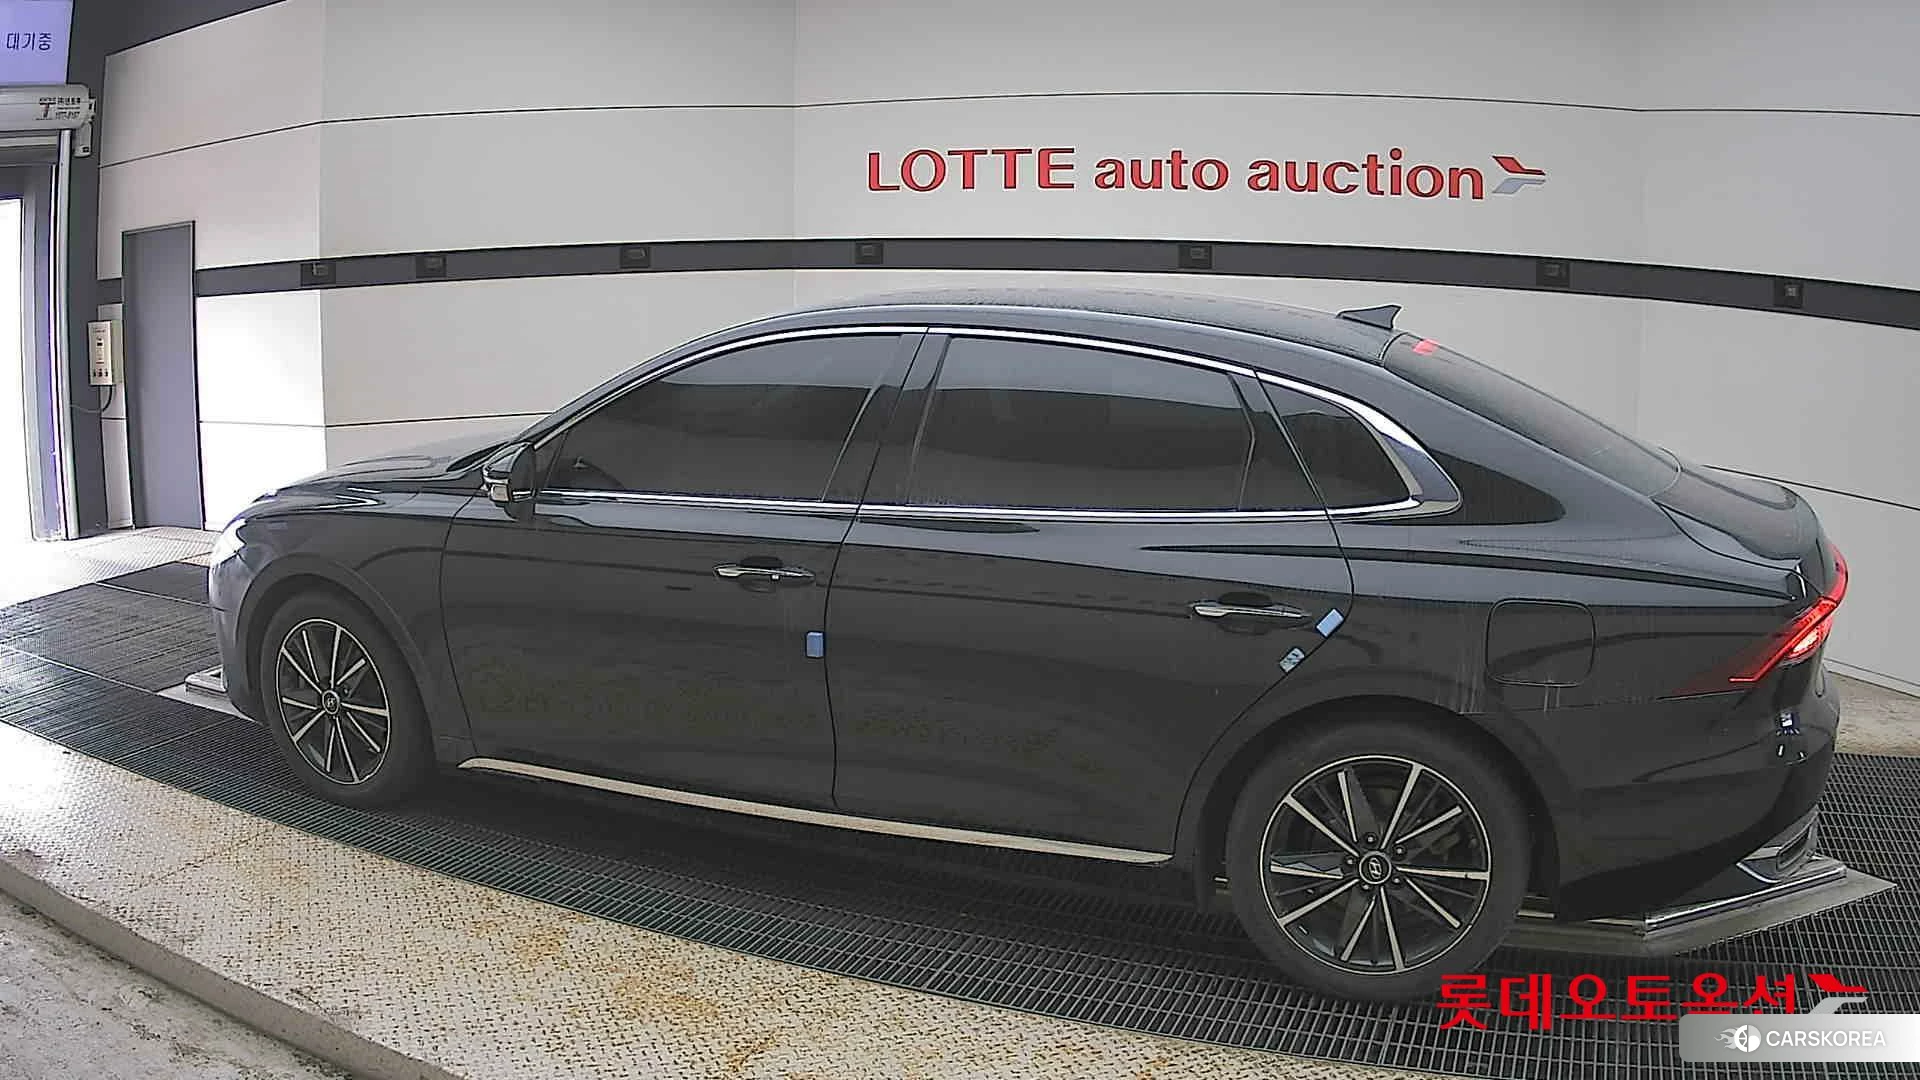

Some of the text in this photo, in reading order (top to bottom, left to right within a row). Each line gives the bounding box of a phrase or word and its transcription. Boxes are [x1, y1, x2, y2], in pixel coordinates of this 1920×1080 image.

[6, 32, 52, 51] 대기중
[868, 147, 1484, 200] LOTTE auto auction
